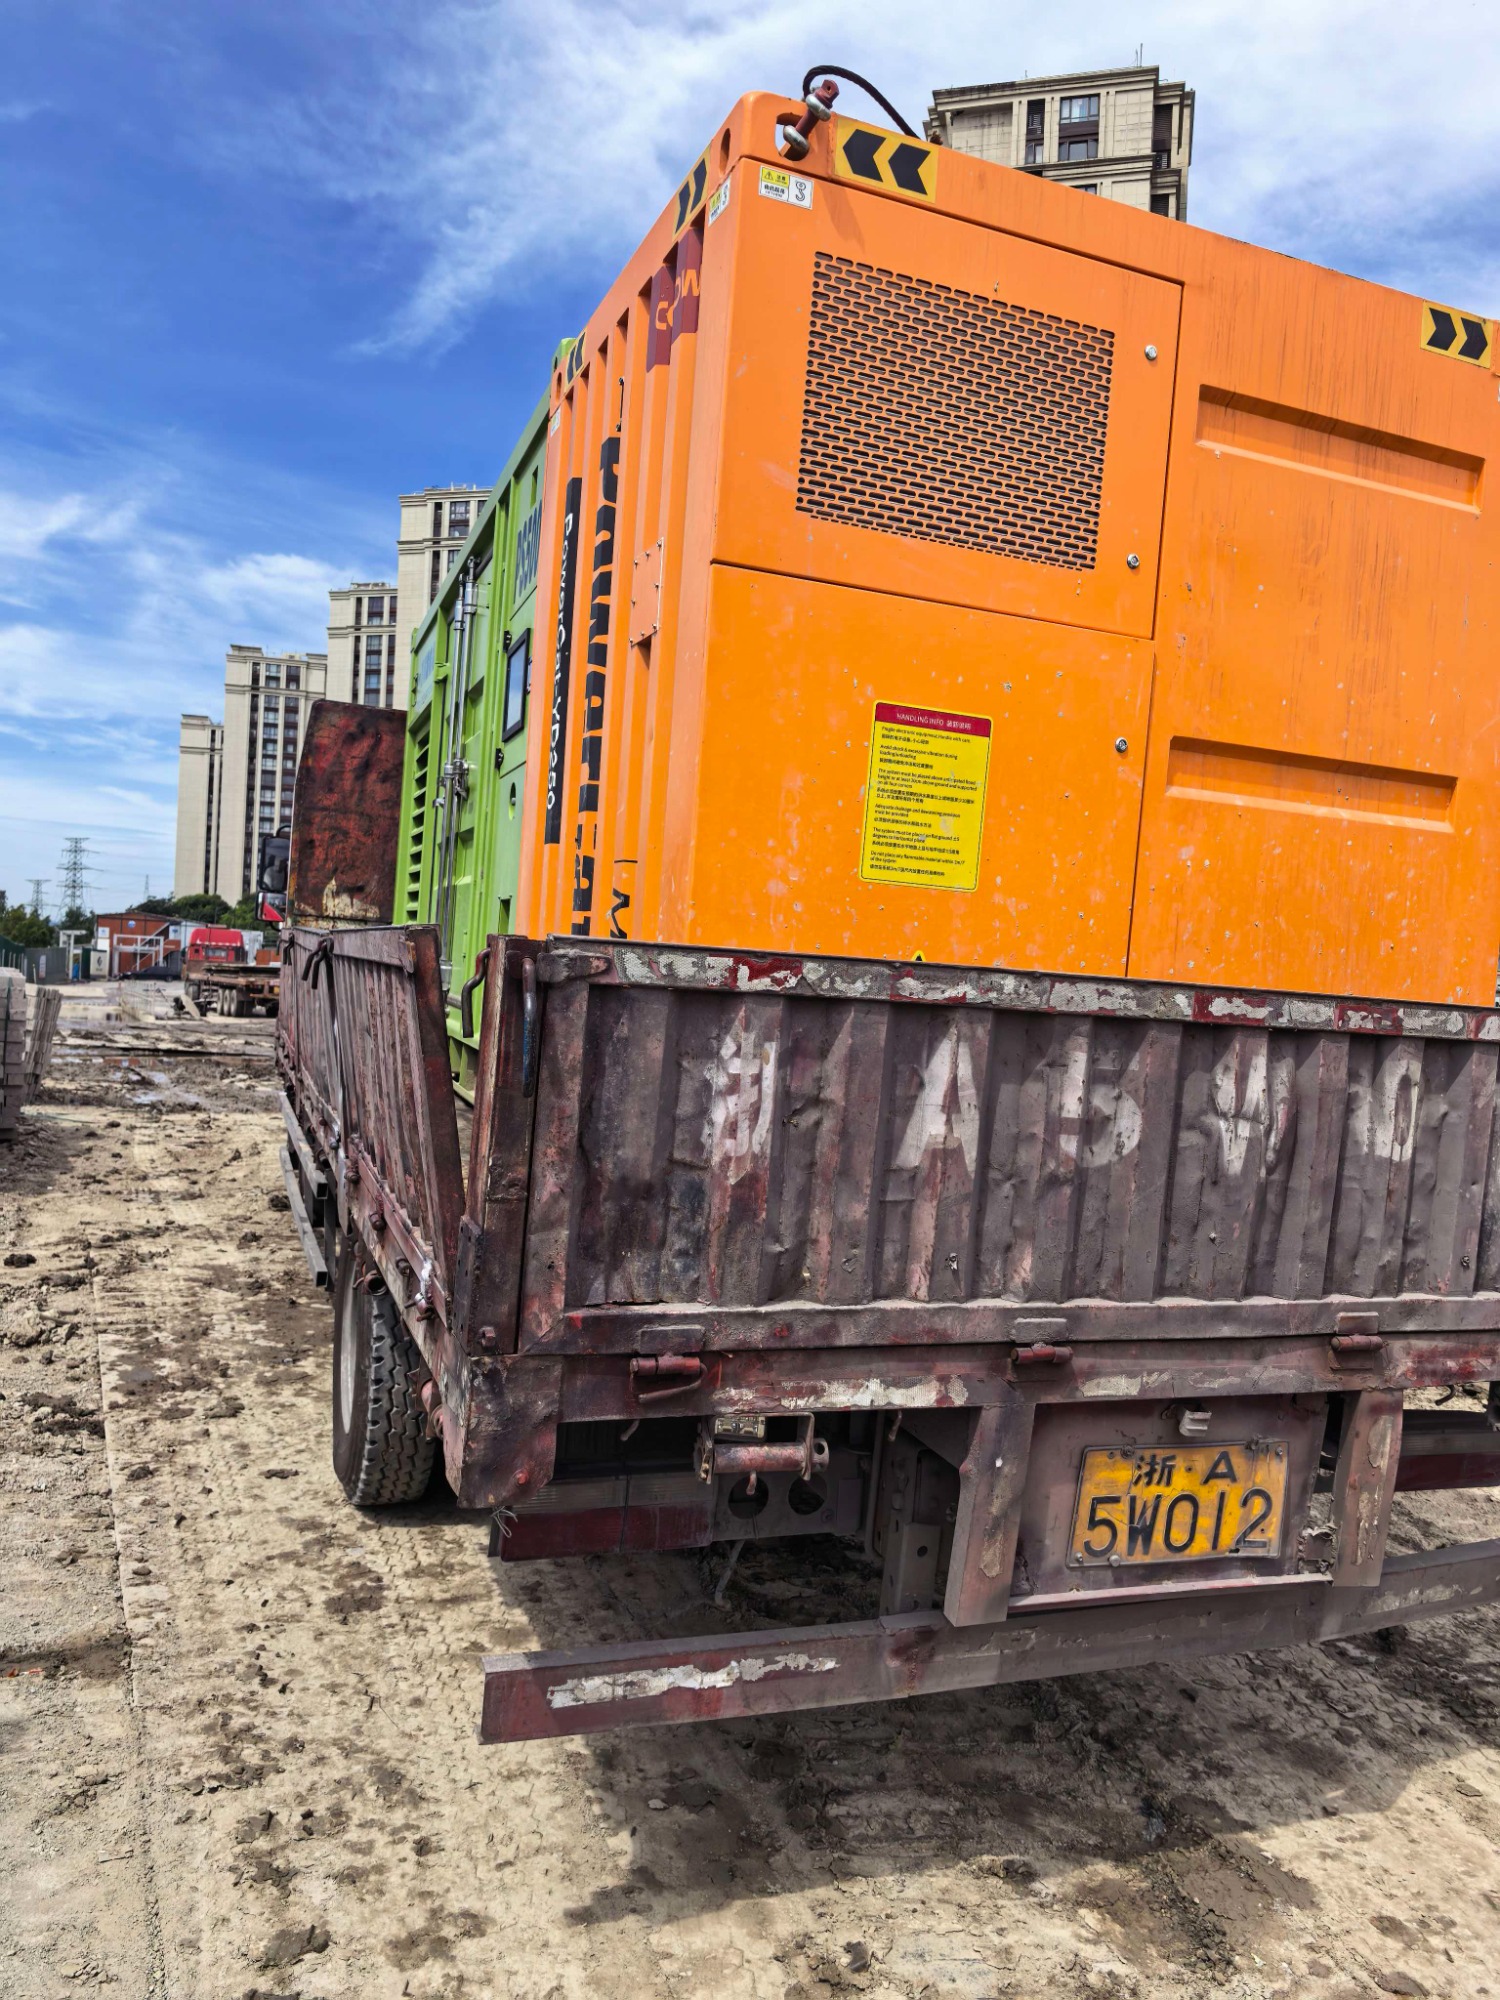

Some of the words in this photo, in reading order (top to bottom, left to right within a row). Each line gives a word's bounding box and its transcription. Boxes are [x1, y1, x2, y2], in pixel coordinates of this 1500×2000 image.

[897, 713, 929, 724] HANDLING
[930, 718, 944, 726] INFO
[1083, 1487, 1273, 1557] 5W012
